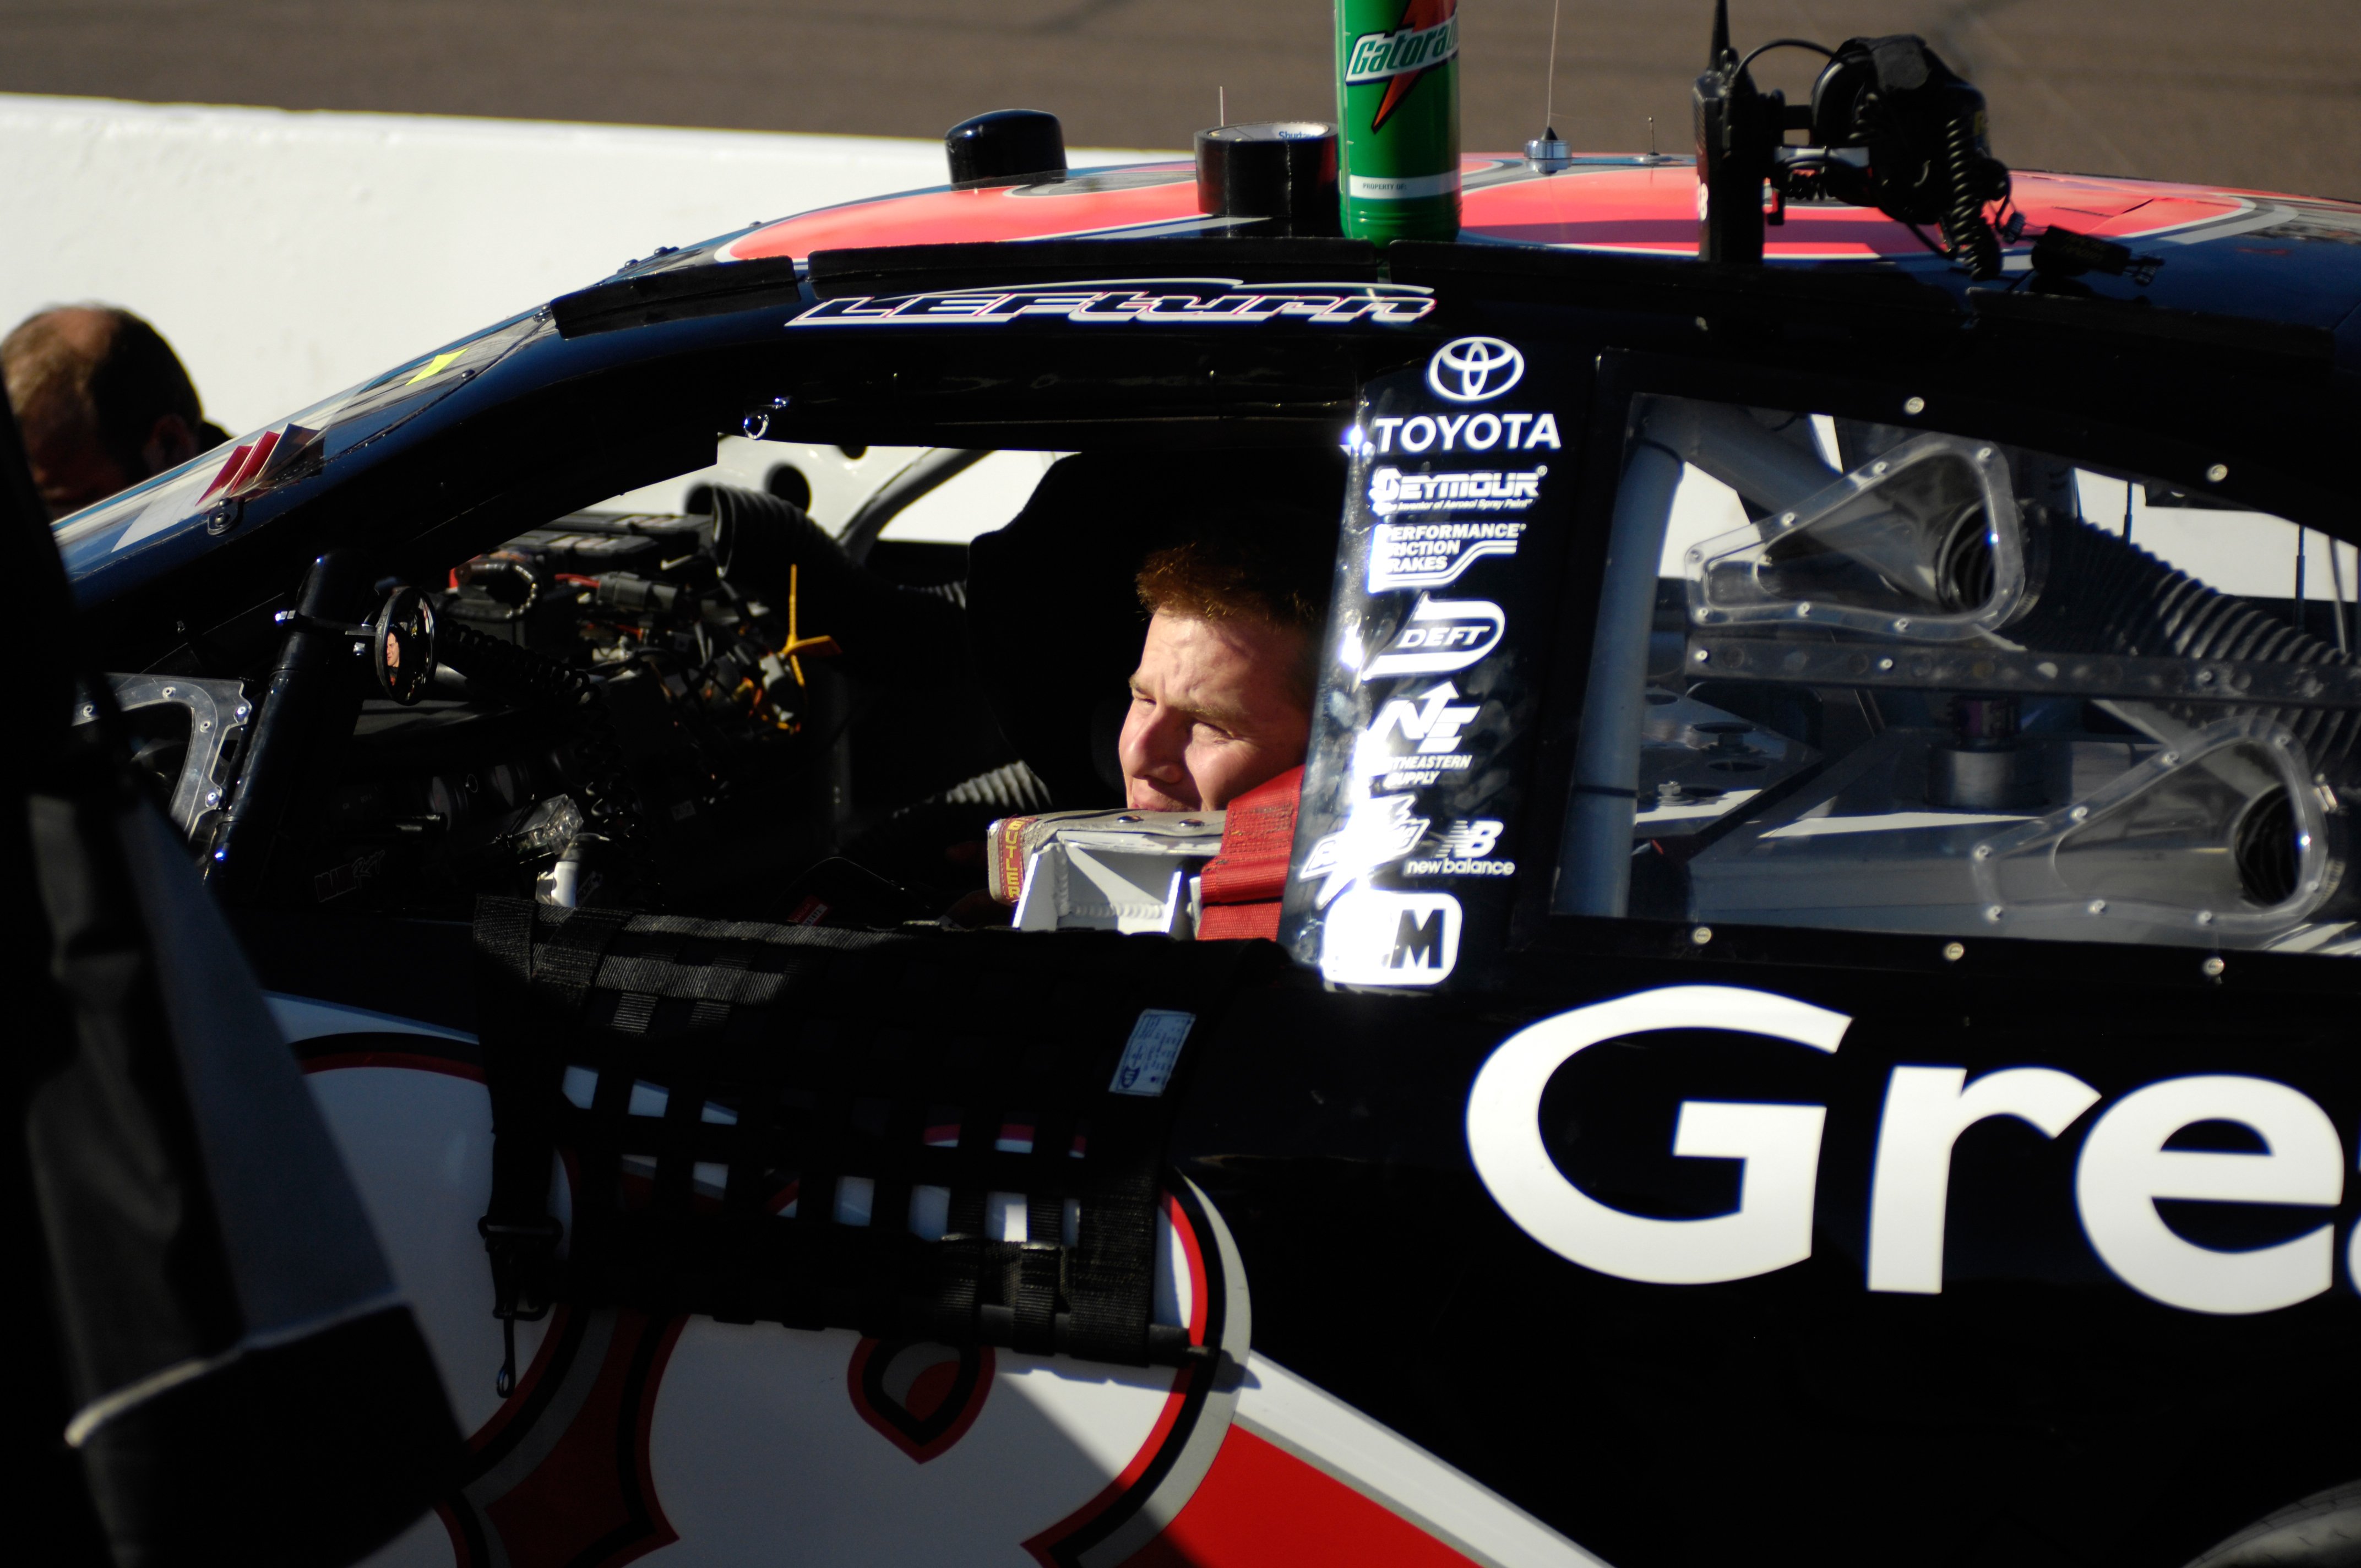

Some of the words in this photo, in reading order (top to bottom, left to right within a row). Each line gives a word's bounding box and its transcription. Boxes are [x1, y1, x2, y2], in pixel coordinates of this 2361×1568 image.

[1375, 413, 1562, 453] TOYOTA
[1370, 468, 1539, 500] SEYMOUR
[1433, 500, 1442, 509] of
[1444, 499, 1478, 509] Aerosol
[1478, 498, 1504, 511] Spray
[1395, 625, 1491, 648] DEFT
[1005, 820, 1020, 898] BUTLER
[1466, 985, 2361, 1315] Gre
